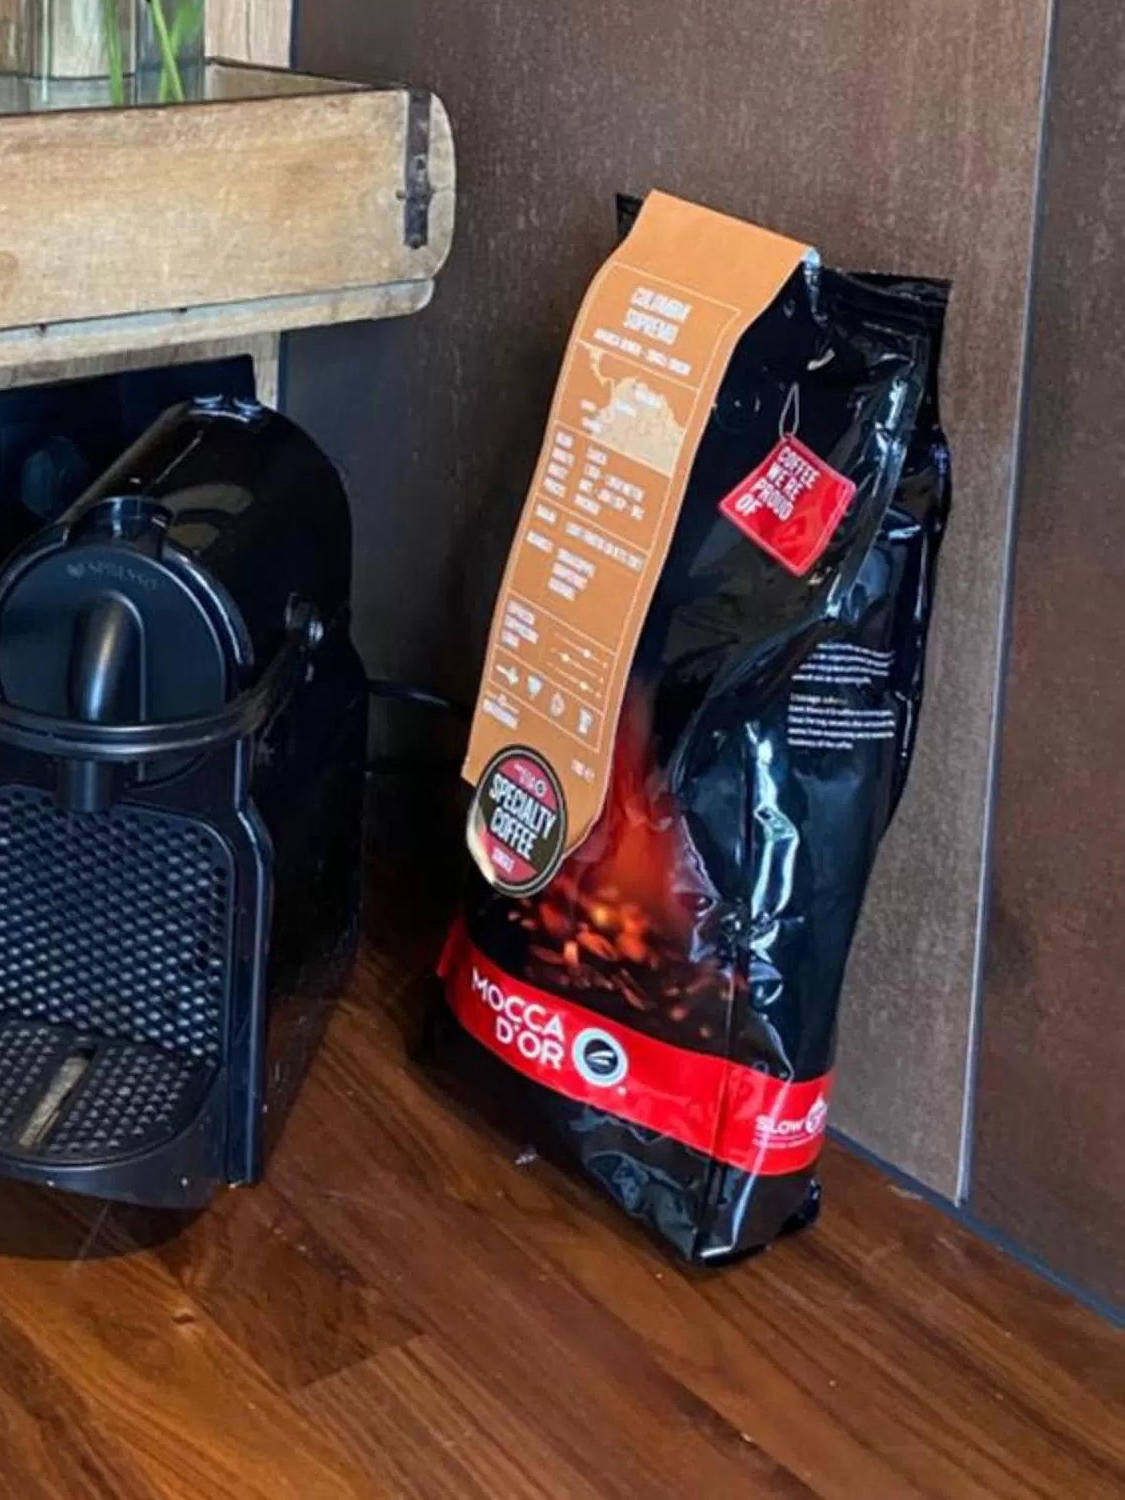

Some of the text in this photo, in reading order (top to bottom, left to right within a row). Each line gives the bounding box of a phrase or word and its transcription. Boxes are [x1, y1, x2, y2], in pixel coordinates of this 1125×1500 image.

[775, 445, 822, 491] COFFEE
[734, 493, 763, 518] OF
[751, 477, 795, 521] PROUD
[488, 772, 557, 840] SPECIALTY
[489, 805, 538, 861] COFFEE
[471, 966, 566, 1042] MOCCA
[495, 1016, 566, 1070] D'OR
